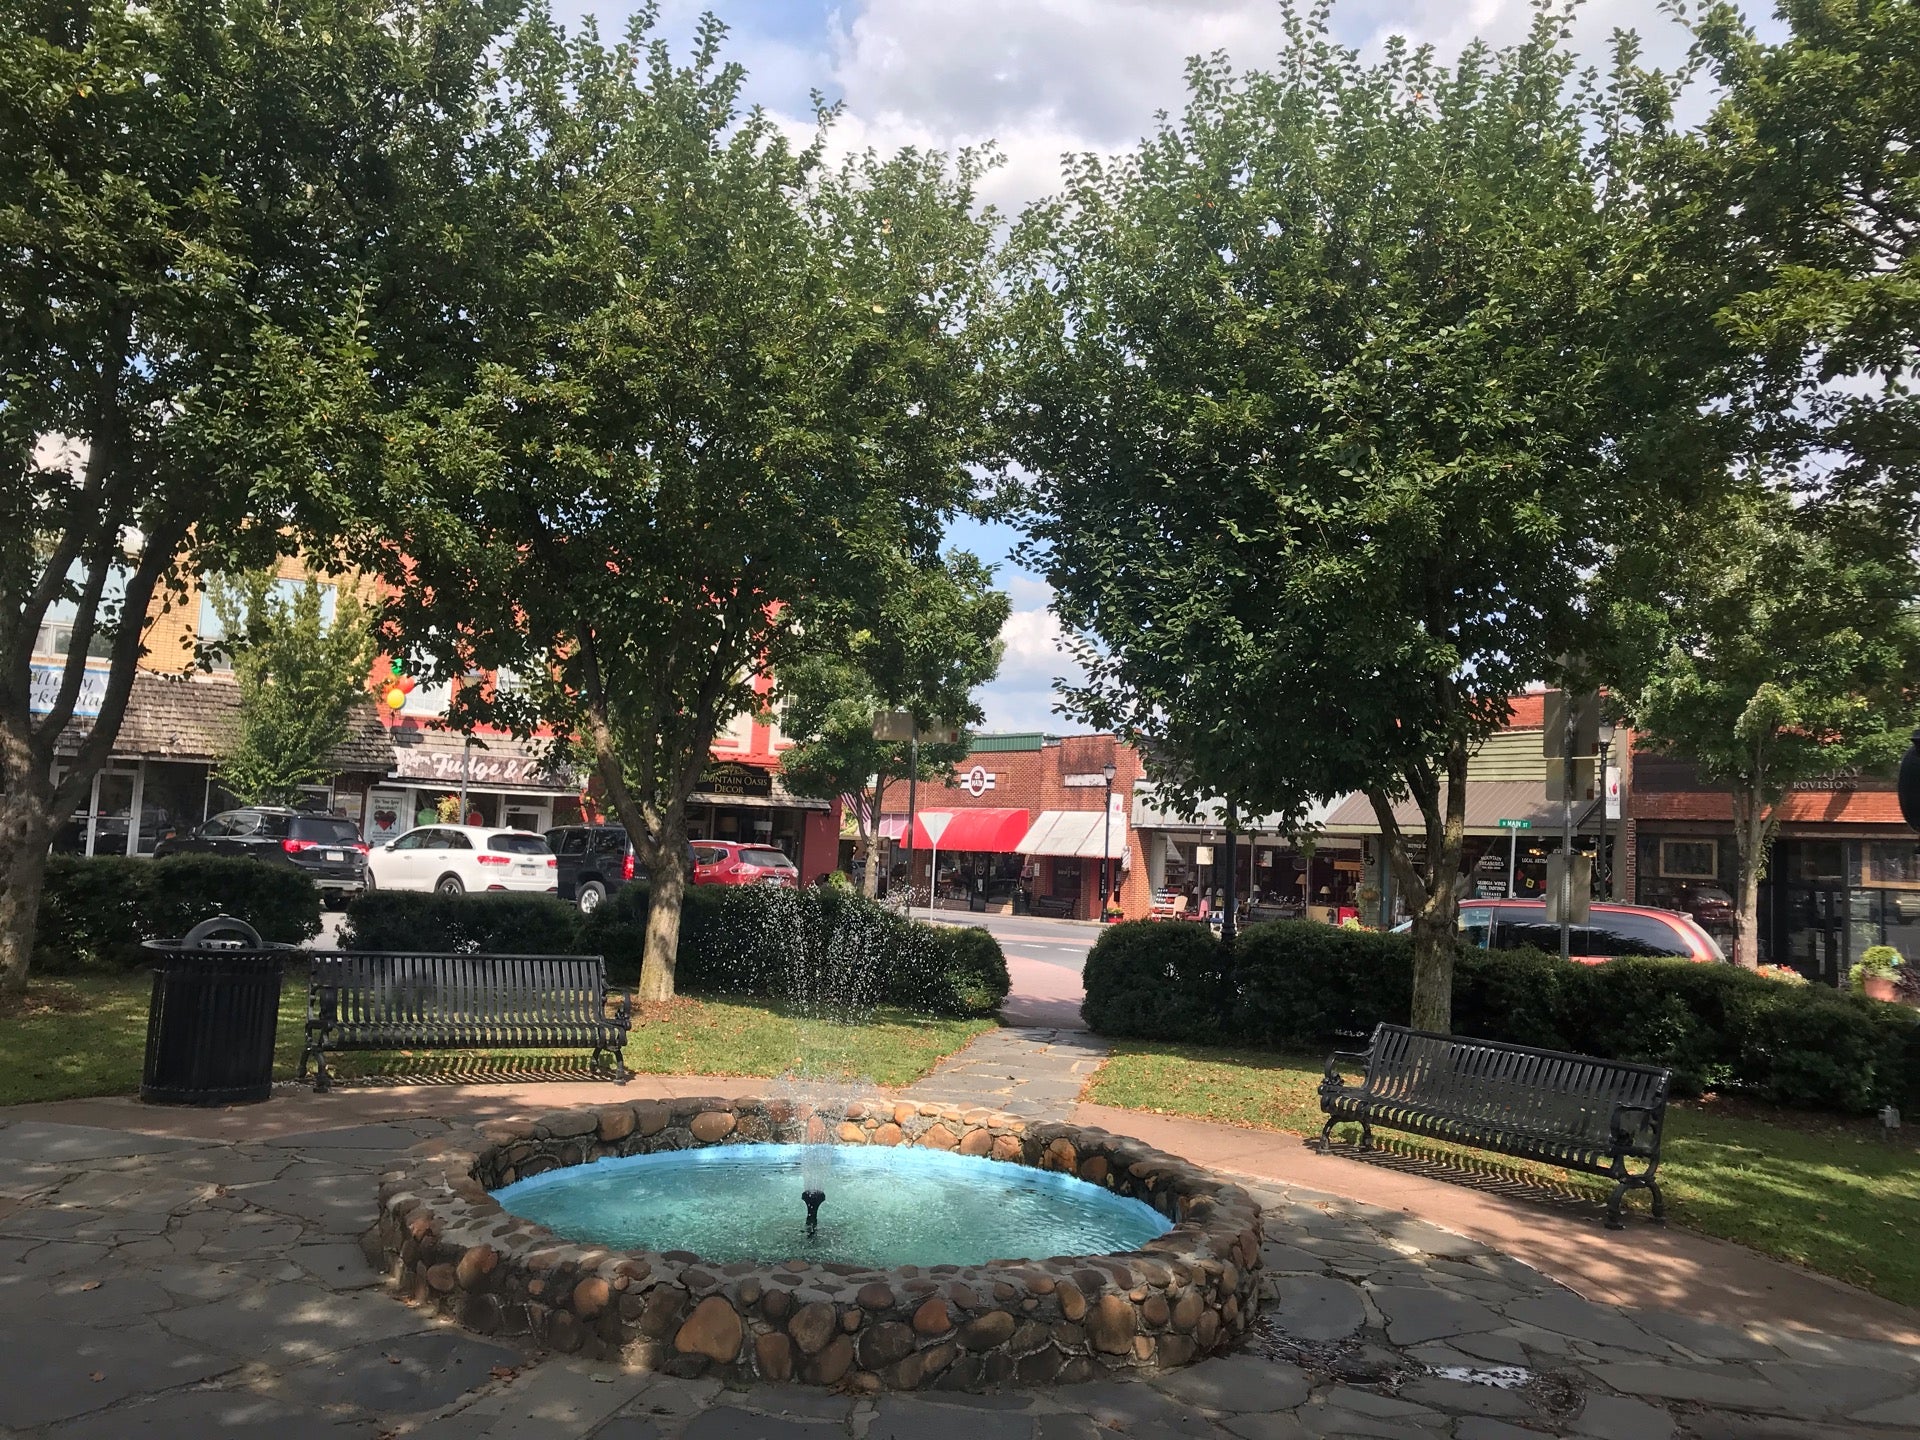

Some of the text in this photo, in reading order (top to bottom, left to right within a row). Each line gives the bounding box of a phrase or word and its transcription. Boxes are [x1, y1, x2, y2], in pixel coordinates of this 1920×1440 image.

[503, 760, 519, 778] &
[744, 776, 768, 786] OASIS
[714, 783, 744, 794] DECOR
[1506, 820, 1522, 828] MAIN
